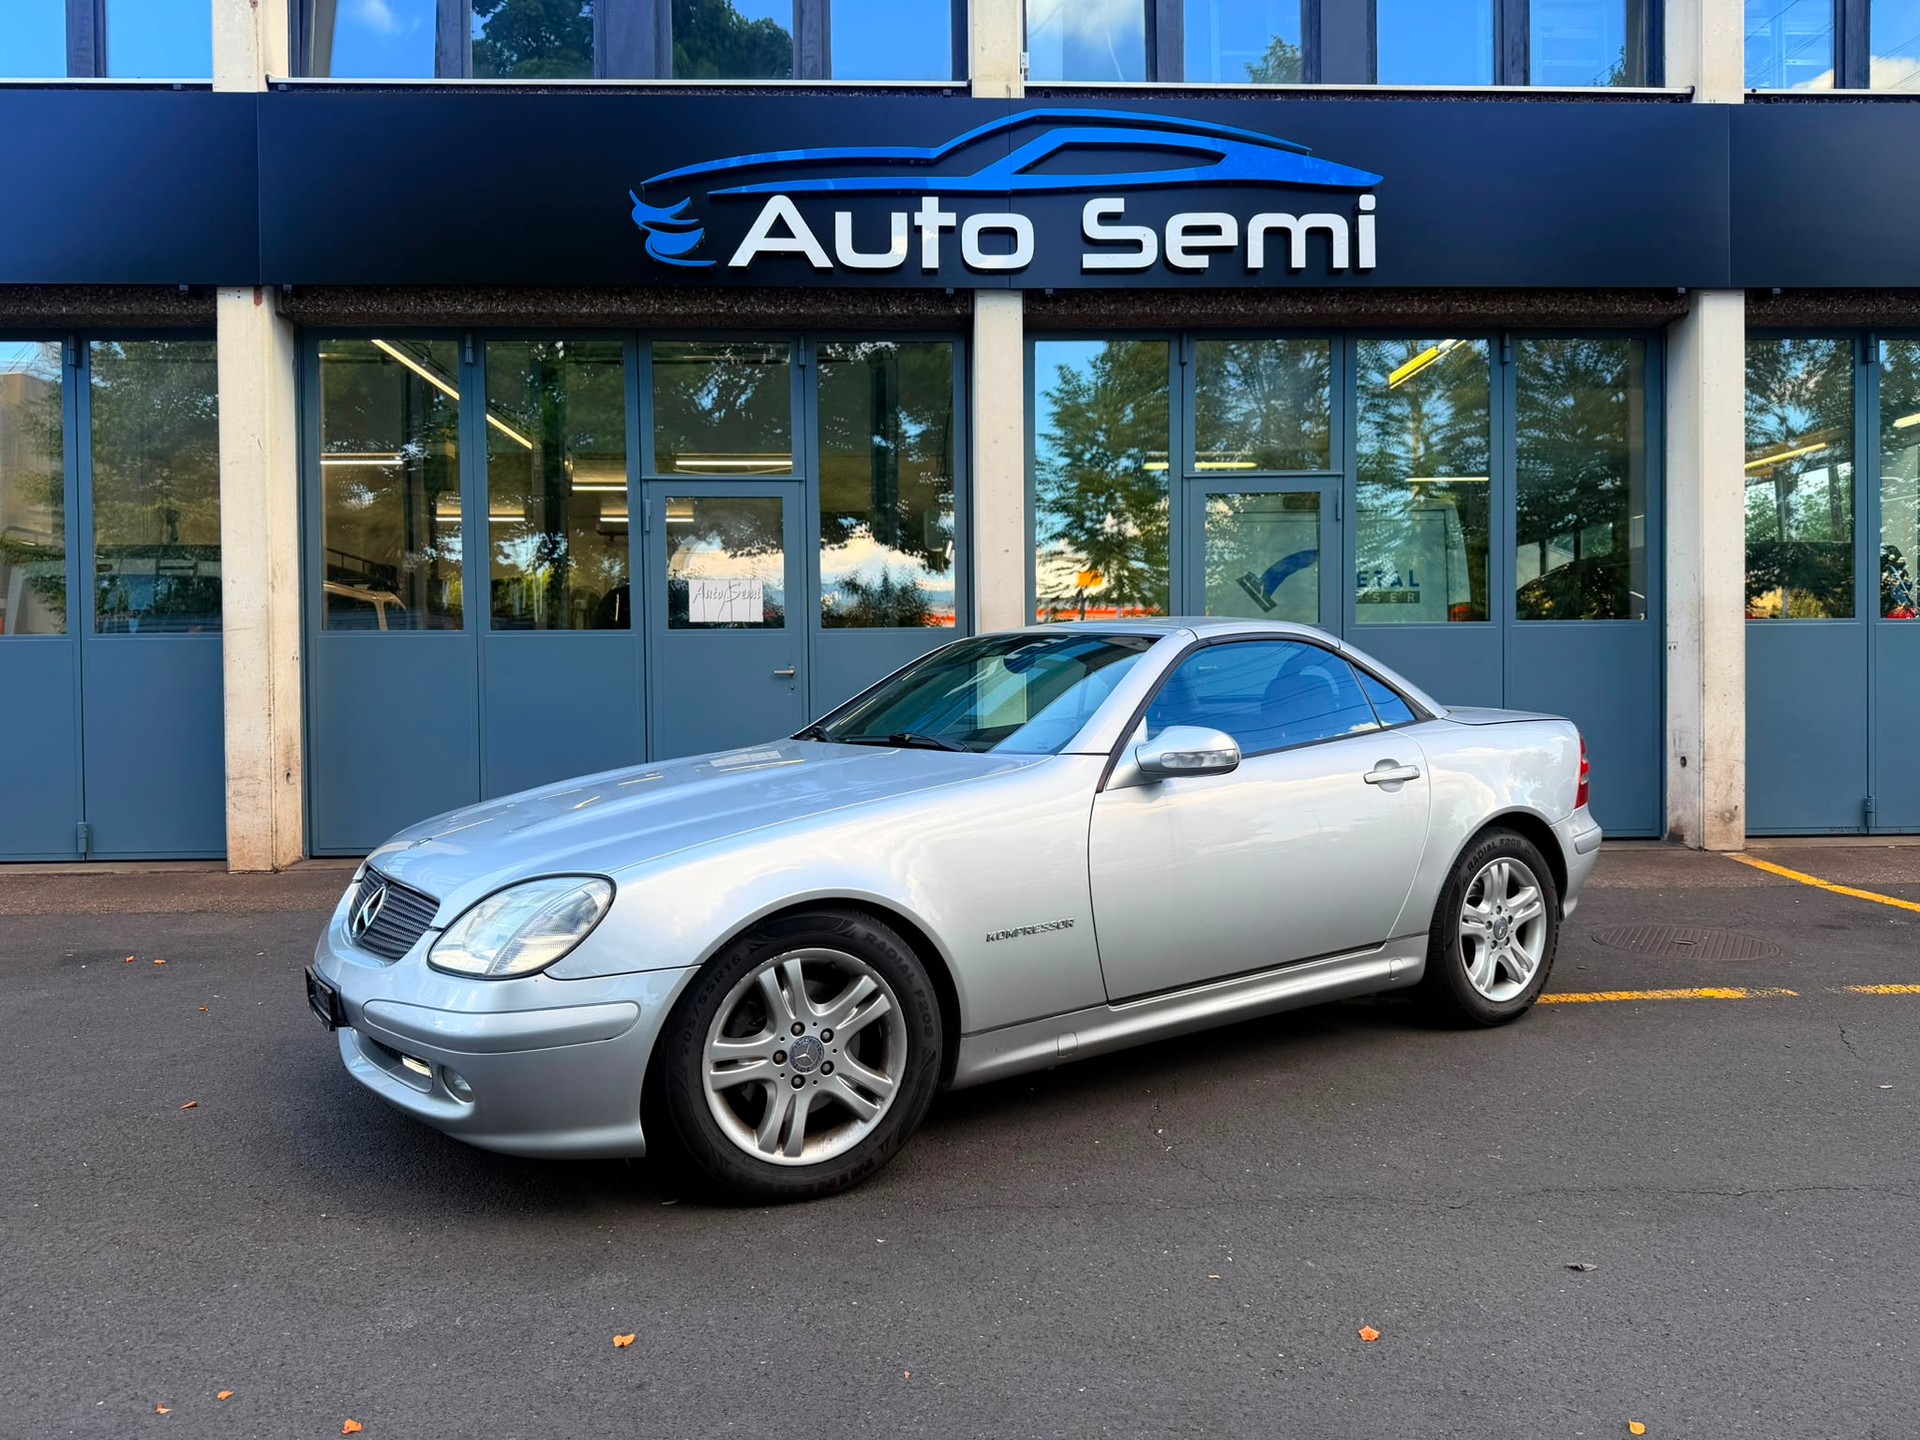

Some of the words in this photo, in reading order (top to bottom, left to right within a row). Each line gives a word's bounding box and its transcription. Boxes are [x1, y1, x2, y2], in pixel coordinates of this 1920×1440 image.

[728, 195, 1035, 269] Auto
[1082, 194, 1376, 269] Semi
[1467, 841, 1497, 872] RADIAL
[986, 918, 1075, 942] KOMPRESSOR
[864, 932, 915, 985] RADIAL
